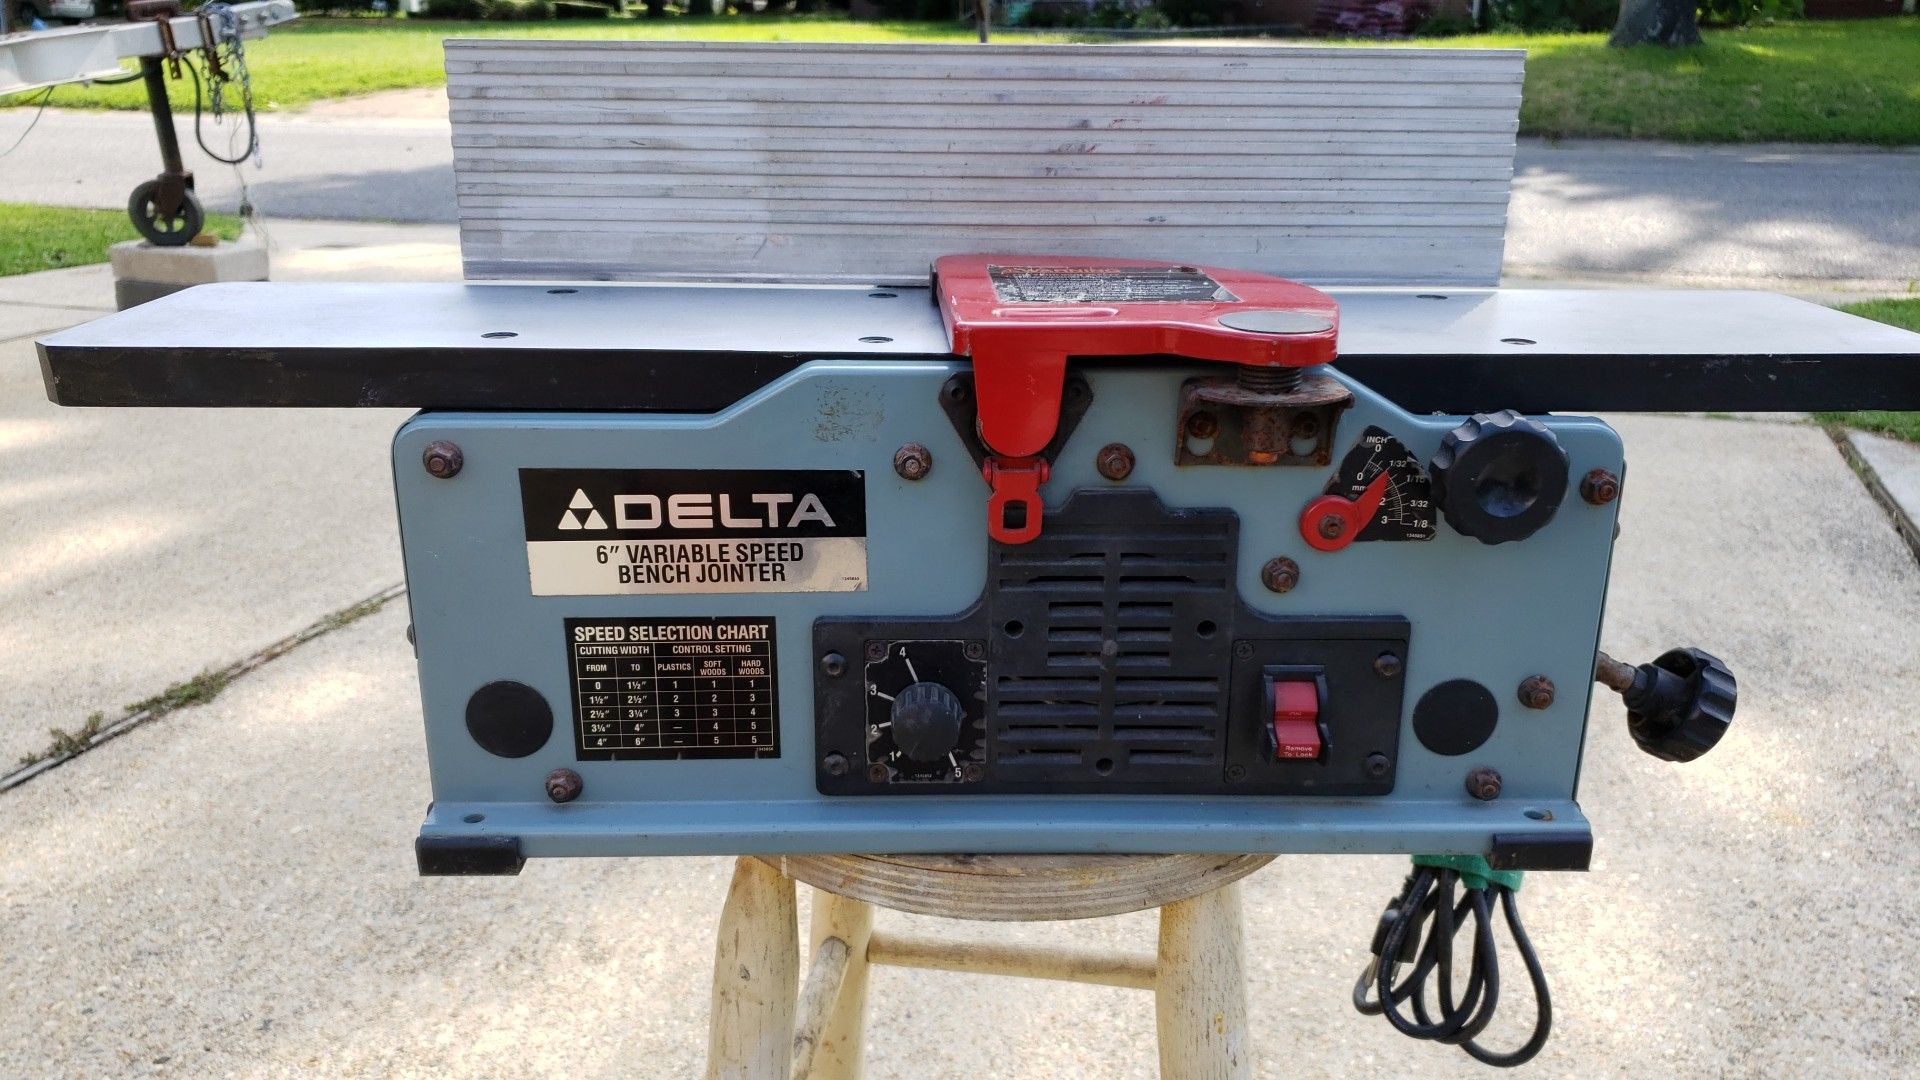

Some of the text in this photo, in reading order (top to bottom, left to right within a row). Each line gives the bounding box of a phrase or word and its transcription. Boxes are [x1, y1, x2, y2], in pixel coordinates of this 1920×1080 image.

[1366, 436, 1388, 444] INCH
[1375, 444, 1382, 452] 0
[1389, 460, 1407, 468] 1/32
[1356, 472, 1363, 481] 0
[1379, 497, 1386, 506] 2
[1410, 500, 1428, 508] 3/32
[614, 493, 837, 529] DELTA
[1381, 516, 1388, 524] 3
[1413, 520, 1428, 528] 1/8
[626, 543, 735, 563] VARIABLE
[736, 542, 804, 562] SPEED
[619, 563, 786, 584] BENCH JOINTER
[574, 624, 769, 641] SPEED SELECTION CHART
[580, 646, 649, 655] CUTTING WIDTH
[672, 644, 751, 654] CONTROL SETTING
[900, 647, 906, 657] 4
[586, 664, 607, 672] FROM
[631, 663, 640, 671] TO
[657, 663, 691, 671] PLASTICS
[704, 660, 721, 668] SOFT
[700, 668, 727, 676] WOODS
[738, 667, 765, 675] WOODS
[595, 681, 601, 690] 0
[673, 681, 678, 689] 1
[712, 680, 717, 688] 1
[750, 680, 754, 688] 1
[870, 684, 877, 695] 3
[673, 695, 679, 703] 2
[712, 694, 718, 702] 2
[750, 693, 755, 702] 3
[674, 708, 680, 717] 3
[712, 708, 718, 717] 3
[750, 707, 756, 716] 4
[713, 722, 719, 730] 4
[751, 722, 757, 730] 5
[871, 724, 878, 734] 2
[713, 736, 720, 744] 5
[751, 735, 757, 744] 5
[889, 751, 895, 761] 1
[955, 767, 962, 778] 5
